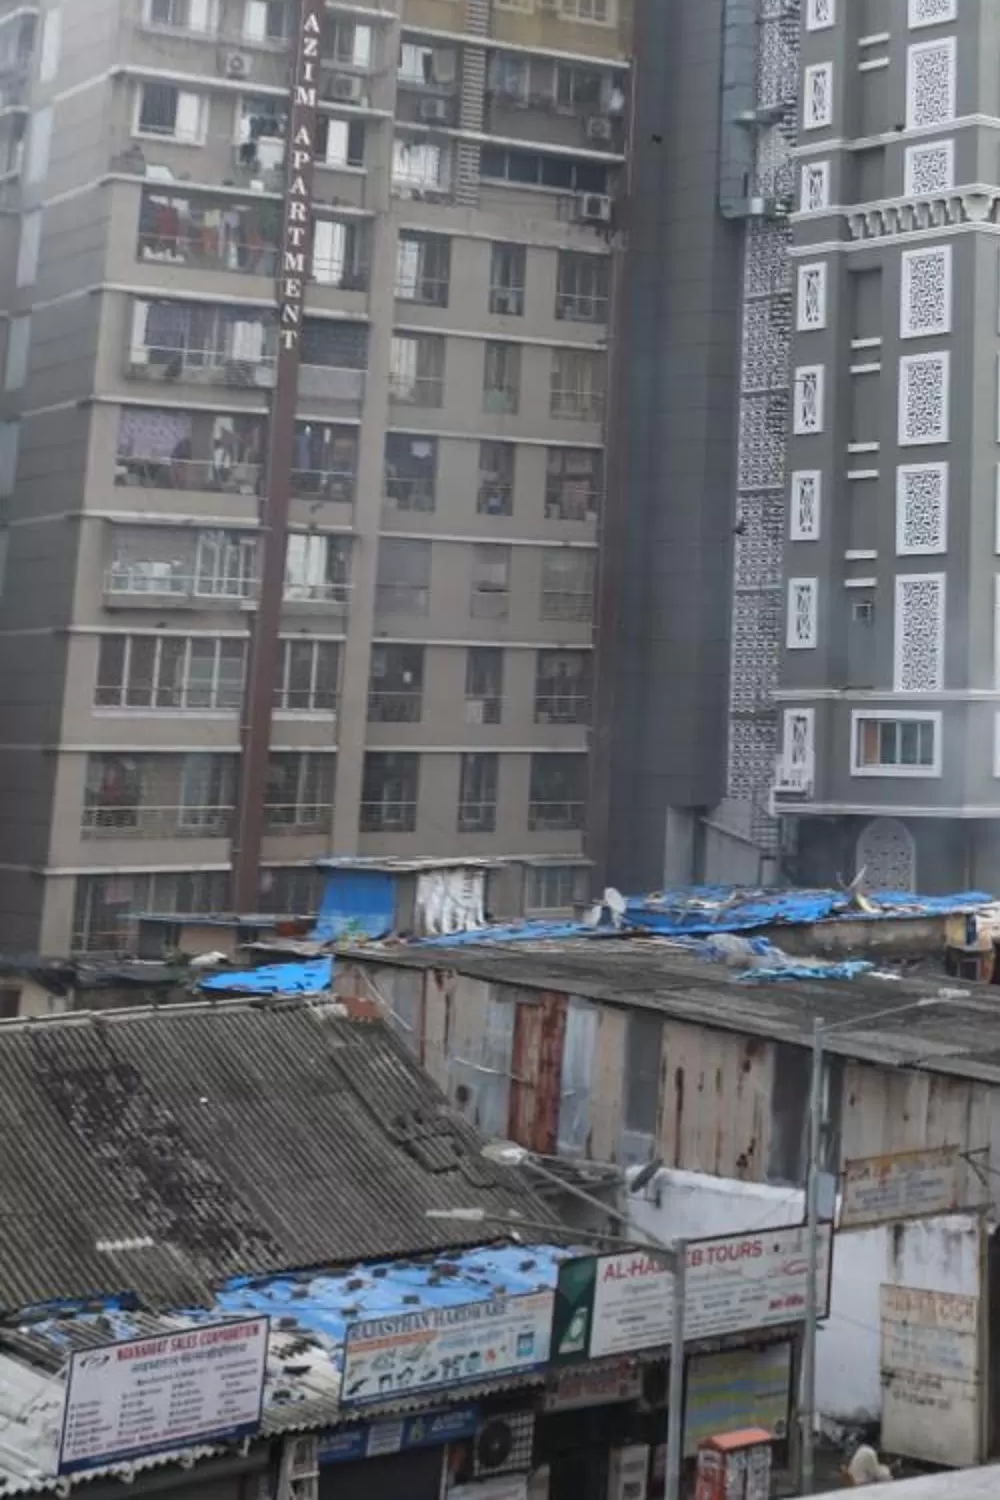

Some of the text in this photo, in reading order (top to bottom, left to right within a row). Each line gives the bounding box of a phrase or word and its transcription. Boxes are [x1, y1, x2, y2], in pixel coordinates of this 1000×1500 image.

[280, 12, 321, 350] AZIM APARTMENT
[706, 1239, 763, 1265] TOURS
[347, 1310, 431, 1342] RAJASTHAN
[437, 1299, 508, 1327] HARDWARE
[171, 1332, 199, 1352] SALES
